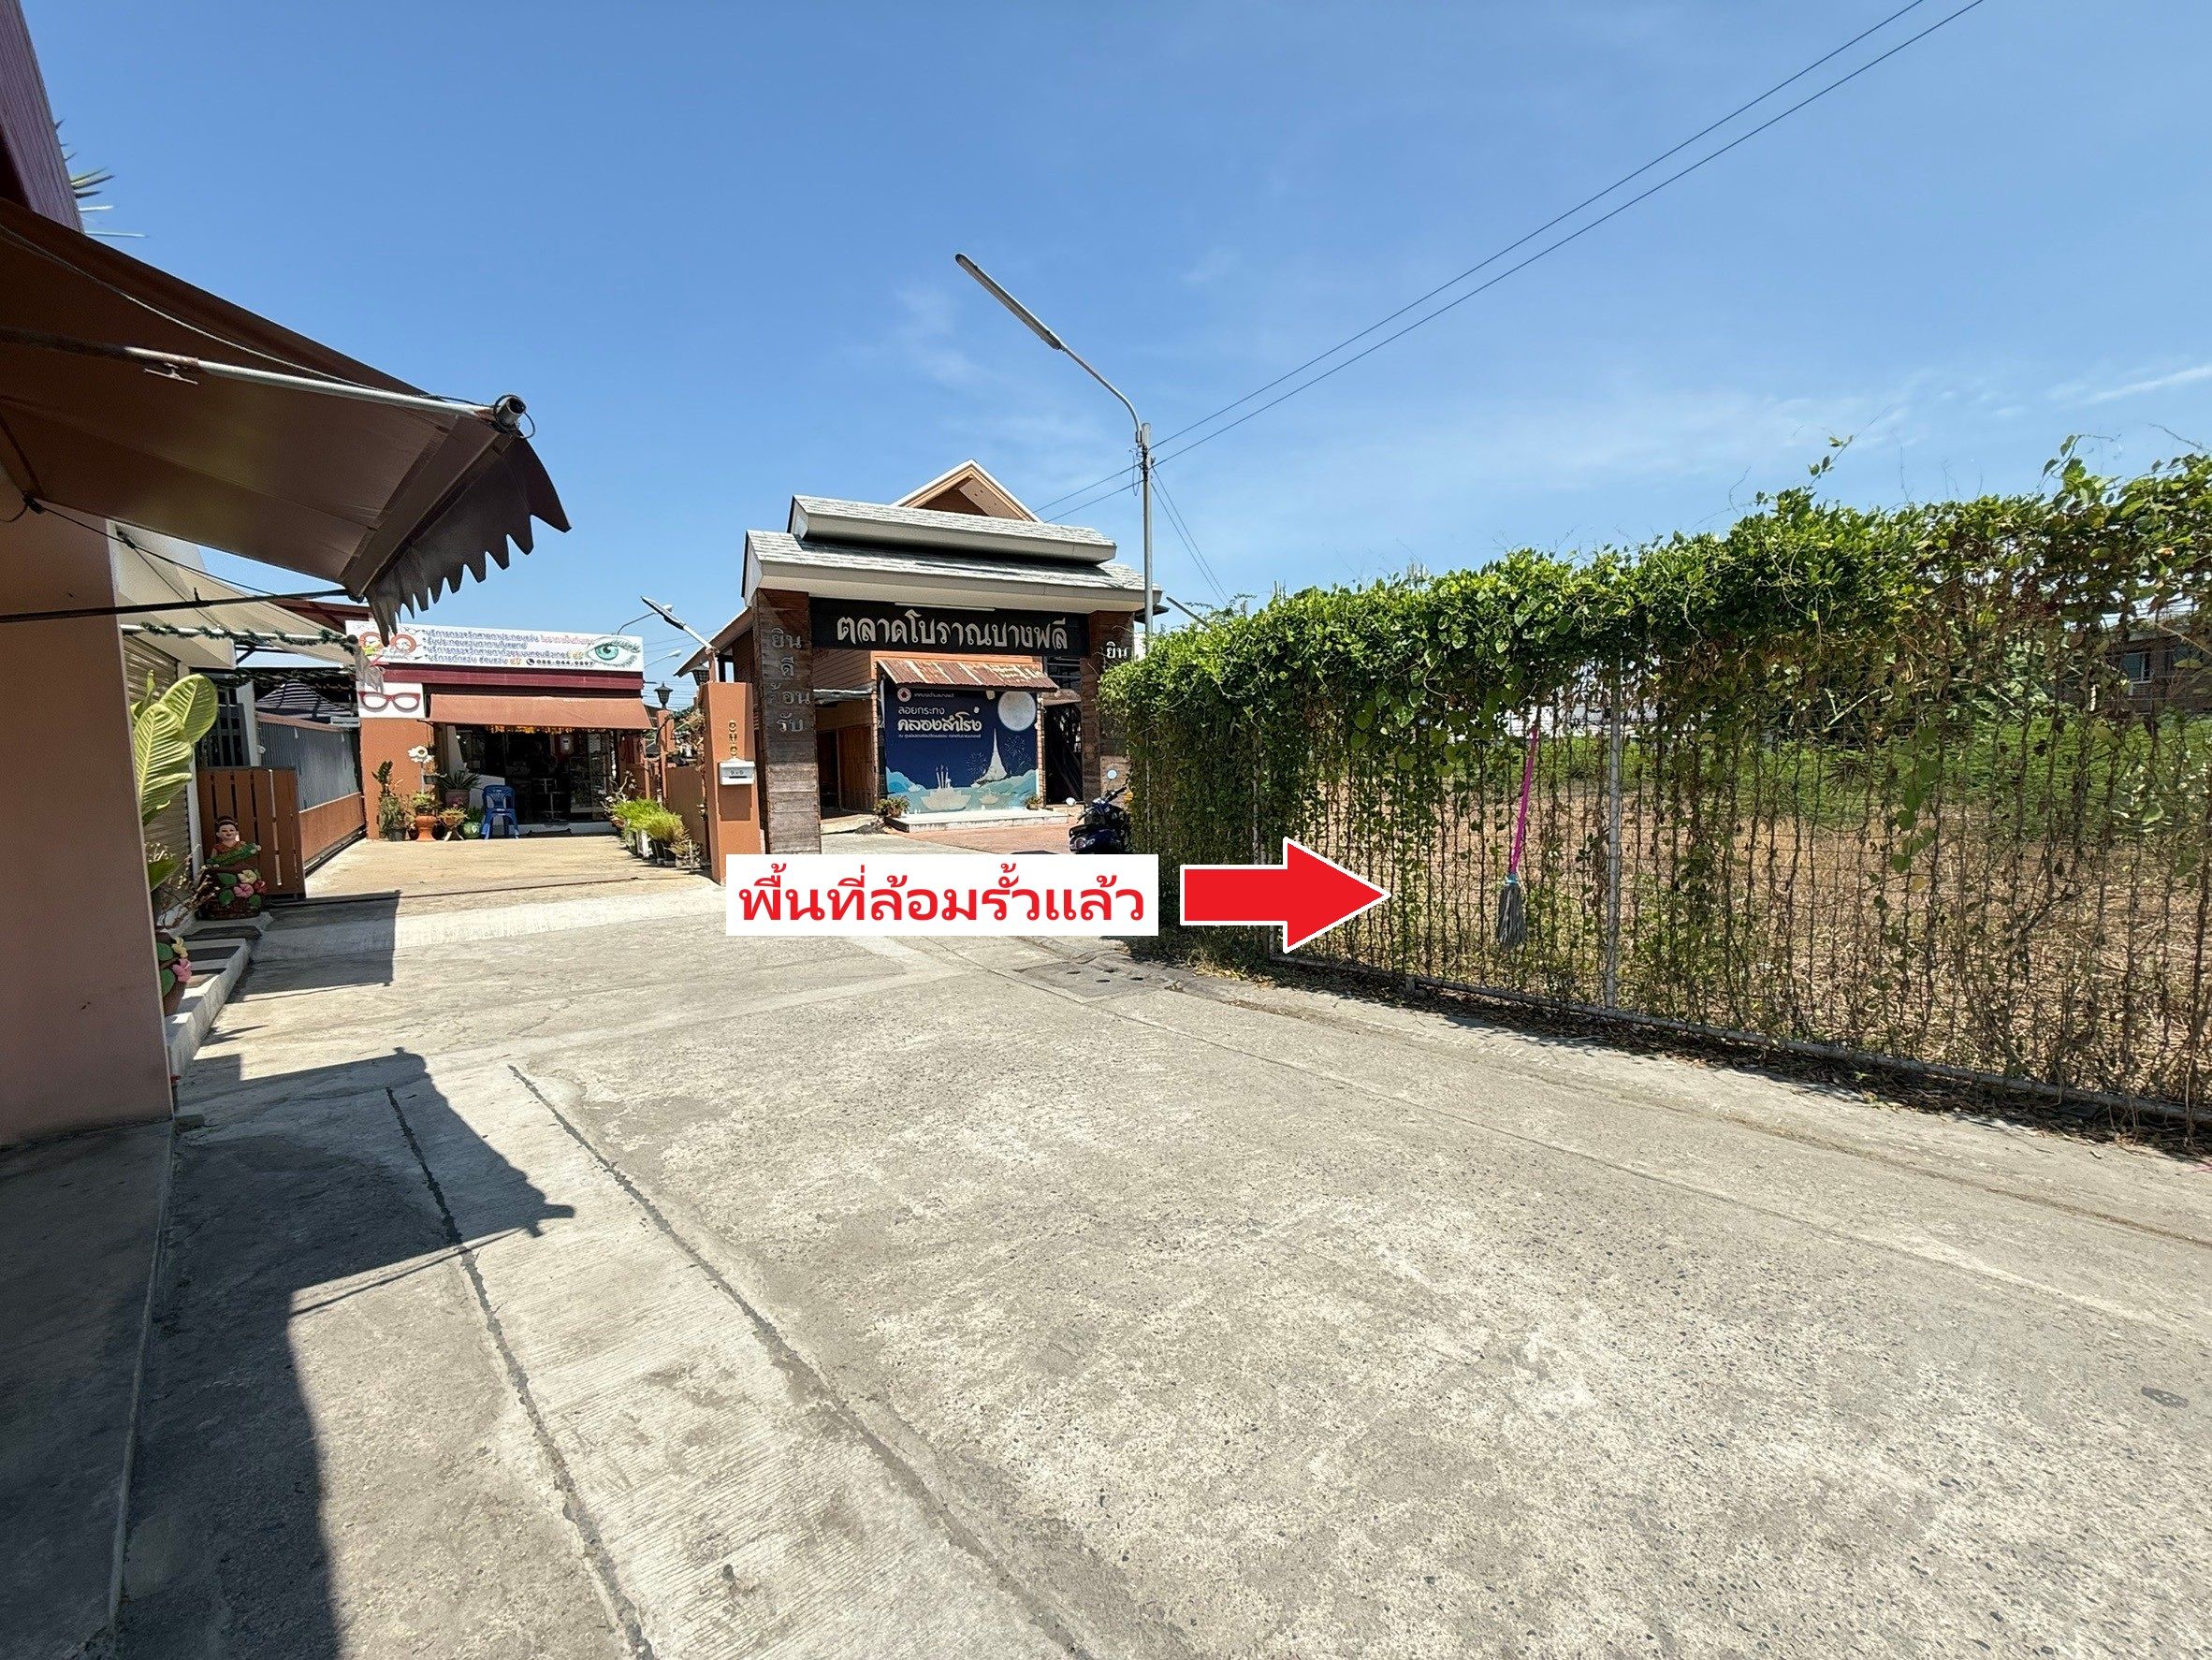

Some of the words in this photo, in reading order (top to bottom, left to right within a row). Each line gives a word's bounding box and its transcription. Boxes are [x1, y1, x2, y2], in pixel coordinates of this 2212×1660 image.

[771, 628, 801, 648] ยิน
[837, 609, 1068, 650] ตลาดโบราณบางพลี
[780, 657, 794, 677] ดี
[897, 706, 945, 715] ลอยกระทง
[776, 712, 804, 733] รับ
[897, 711, 982, 733] คลองสำโรง
